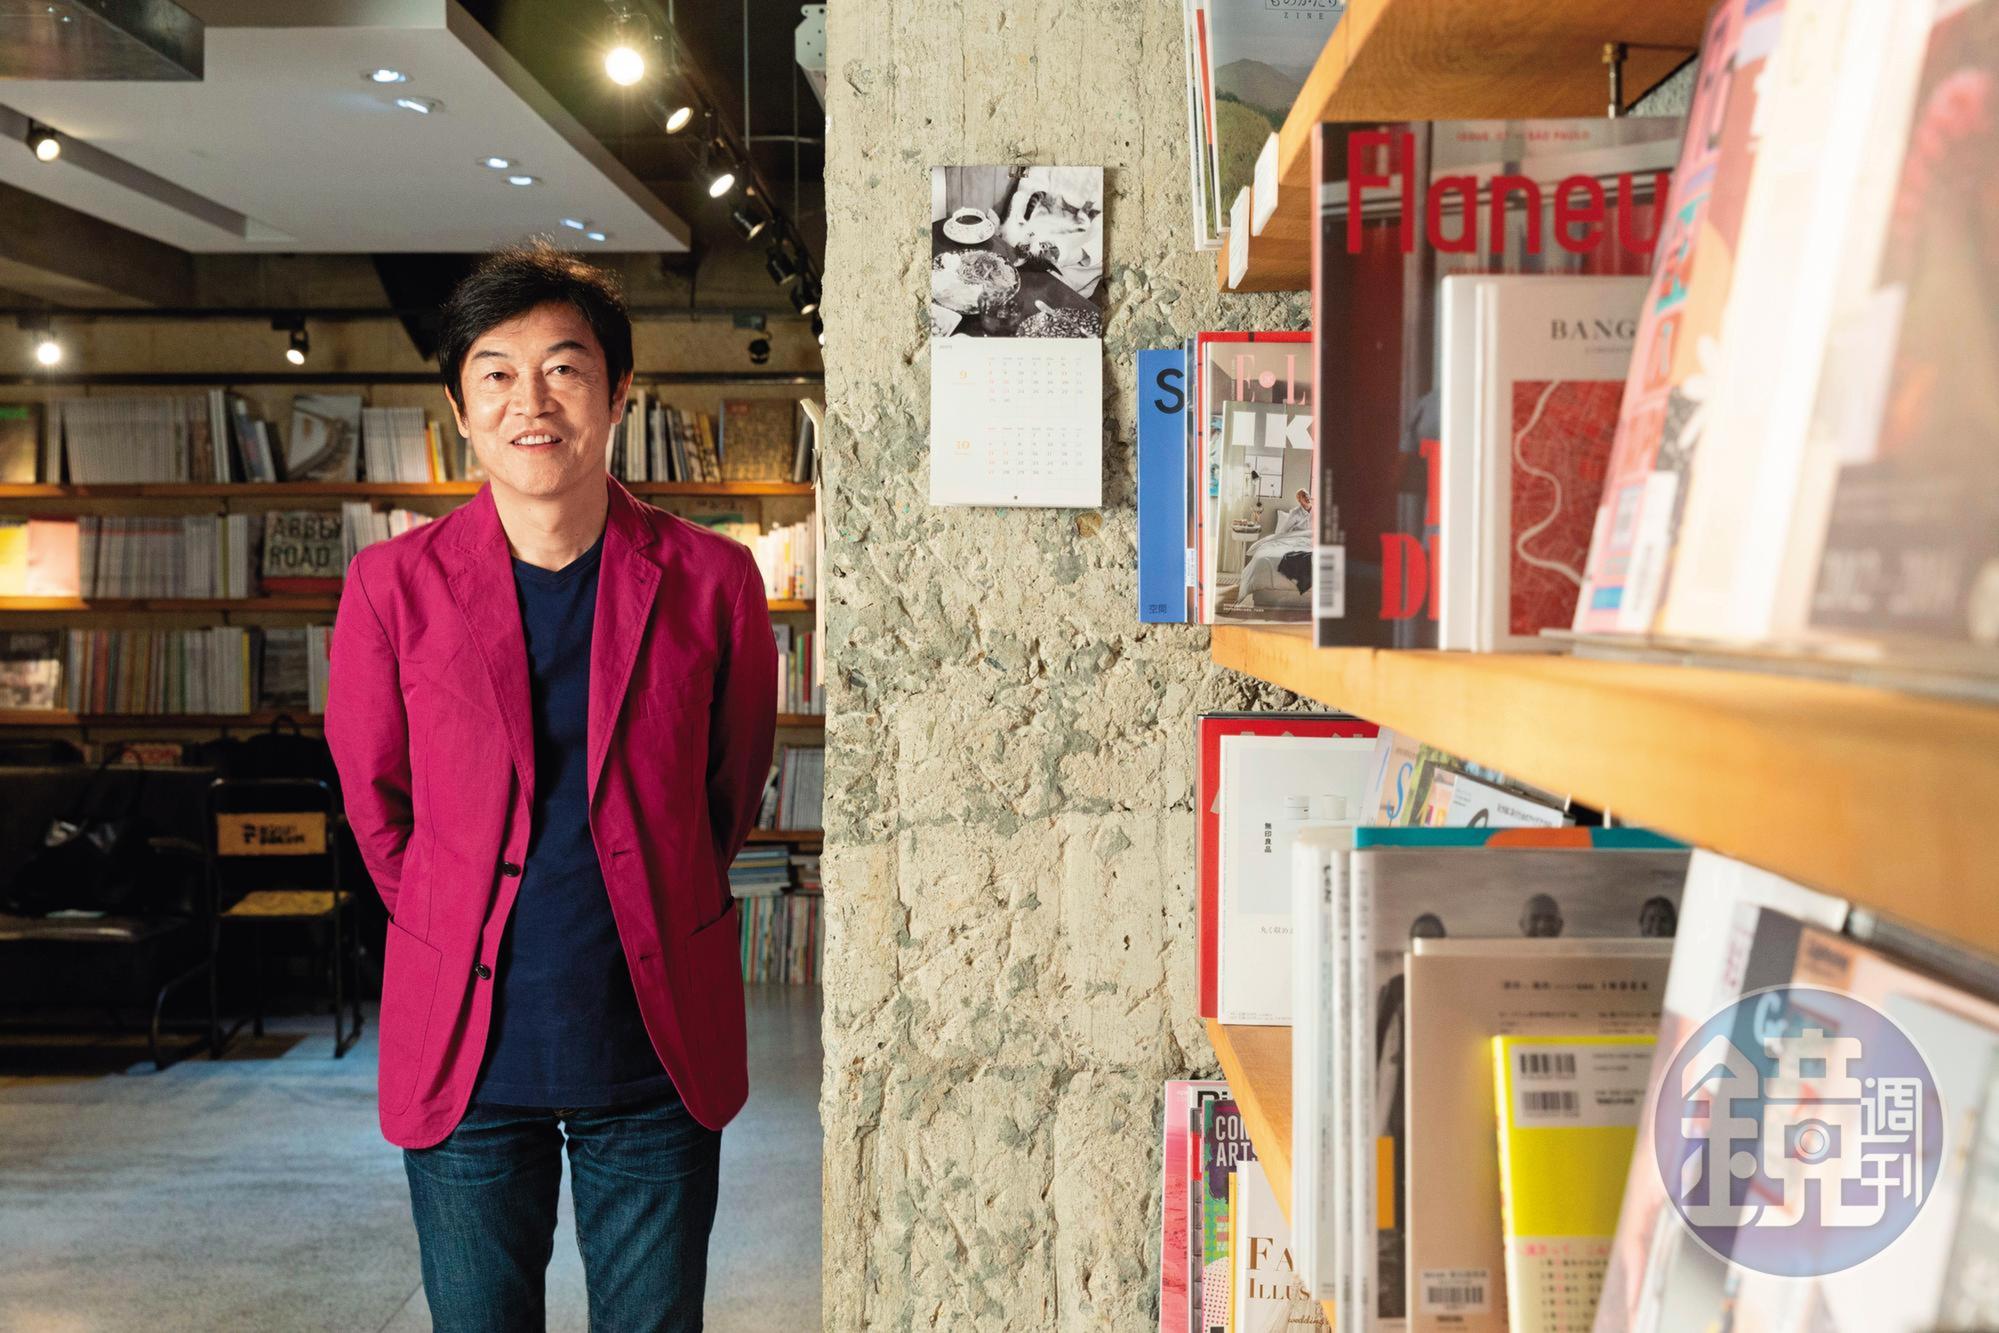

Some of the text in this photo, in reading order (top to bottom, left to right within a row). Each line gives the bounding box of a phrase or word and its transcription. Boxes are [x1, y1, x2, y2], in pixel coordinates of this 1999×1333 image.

[1551, 319, 1636, 340] BANG
[1154, 368, 1184, 414] S
[271, 545, 330, 568] ROAD
[1264, 822, 1272, 853] 無印良品
[1246, 1236, 1293, 1272] FA
